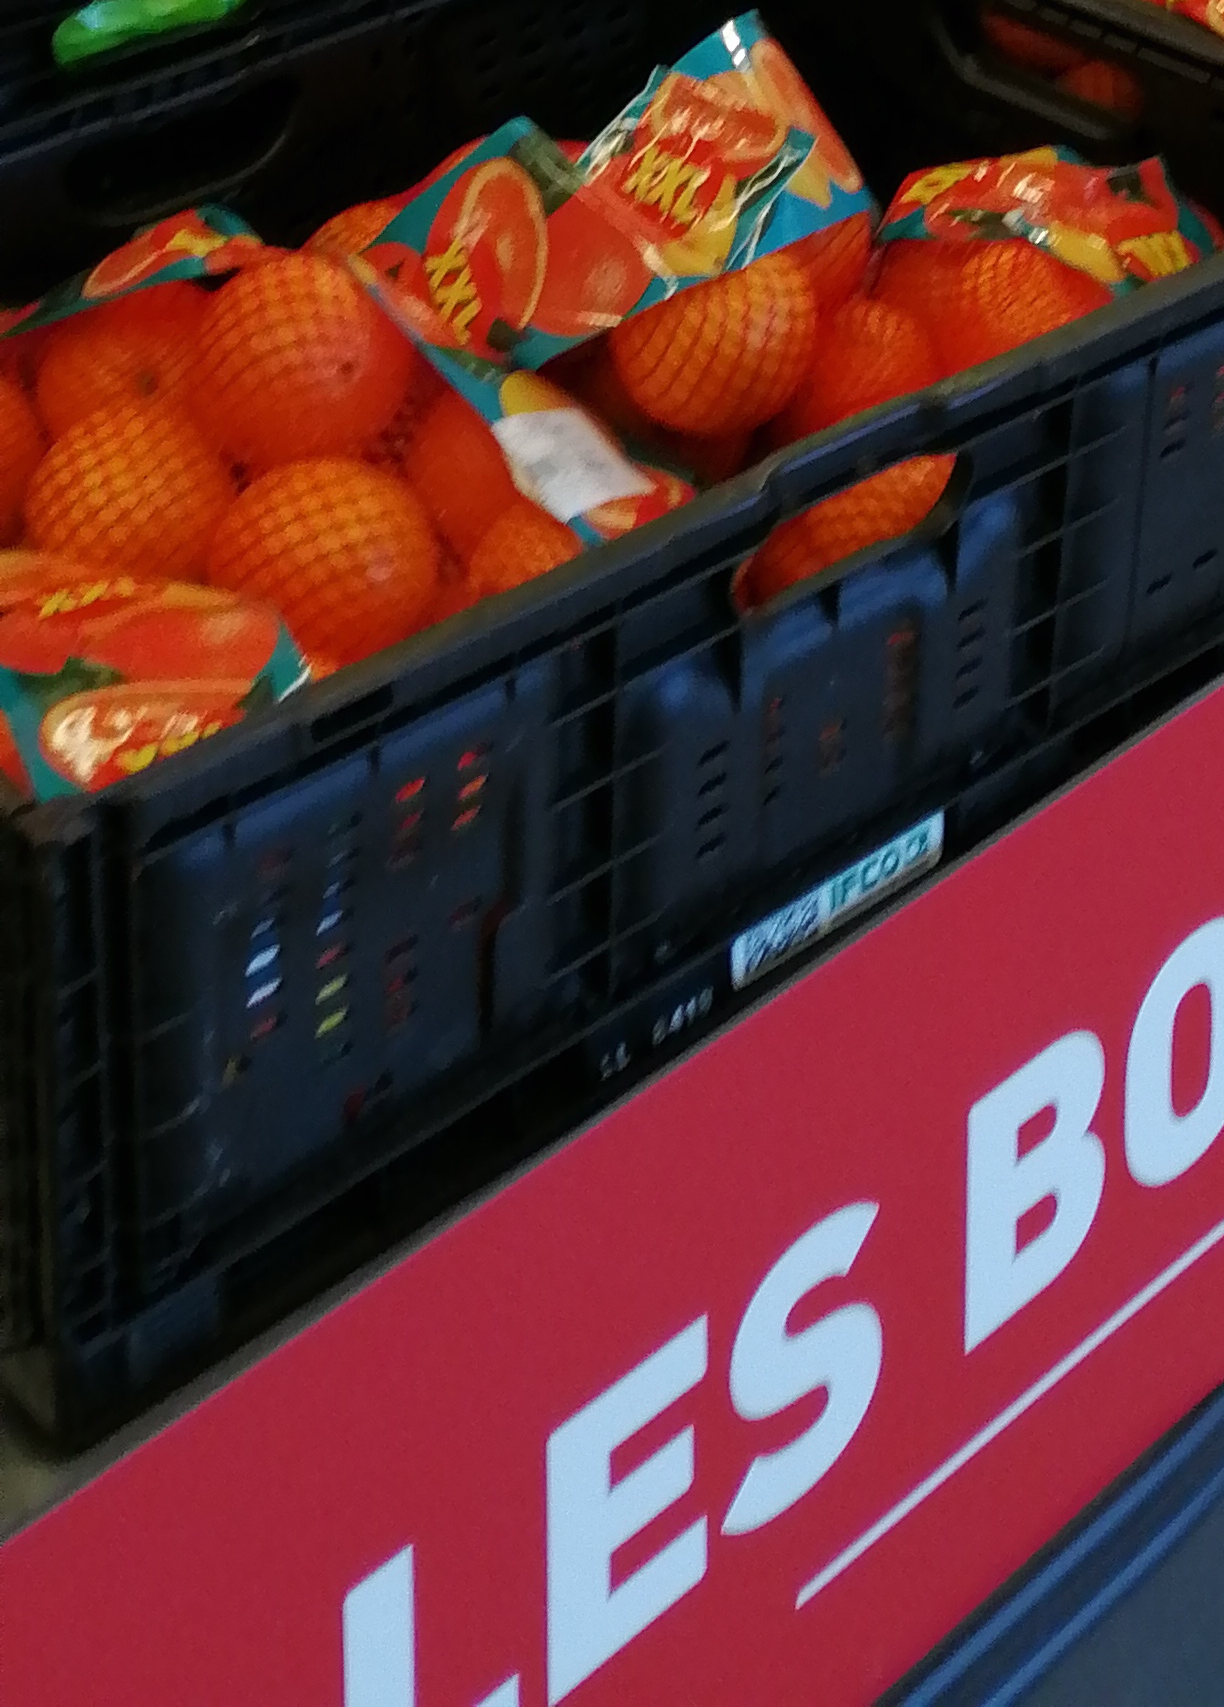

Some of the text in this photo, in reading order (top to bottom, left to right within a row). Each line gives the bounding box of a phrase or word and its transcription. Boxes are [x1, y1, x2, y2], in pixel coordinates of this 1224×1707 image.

[622, 147, 710, 228] XXL
[424, 239, 482, 347] XXL
[827, 847, 901, 913] IFCO
